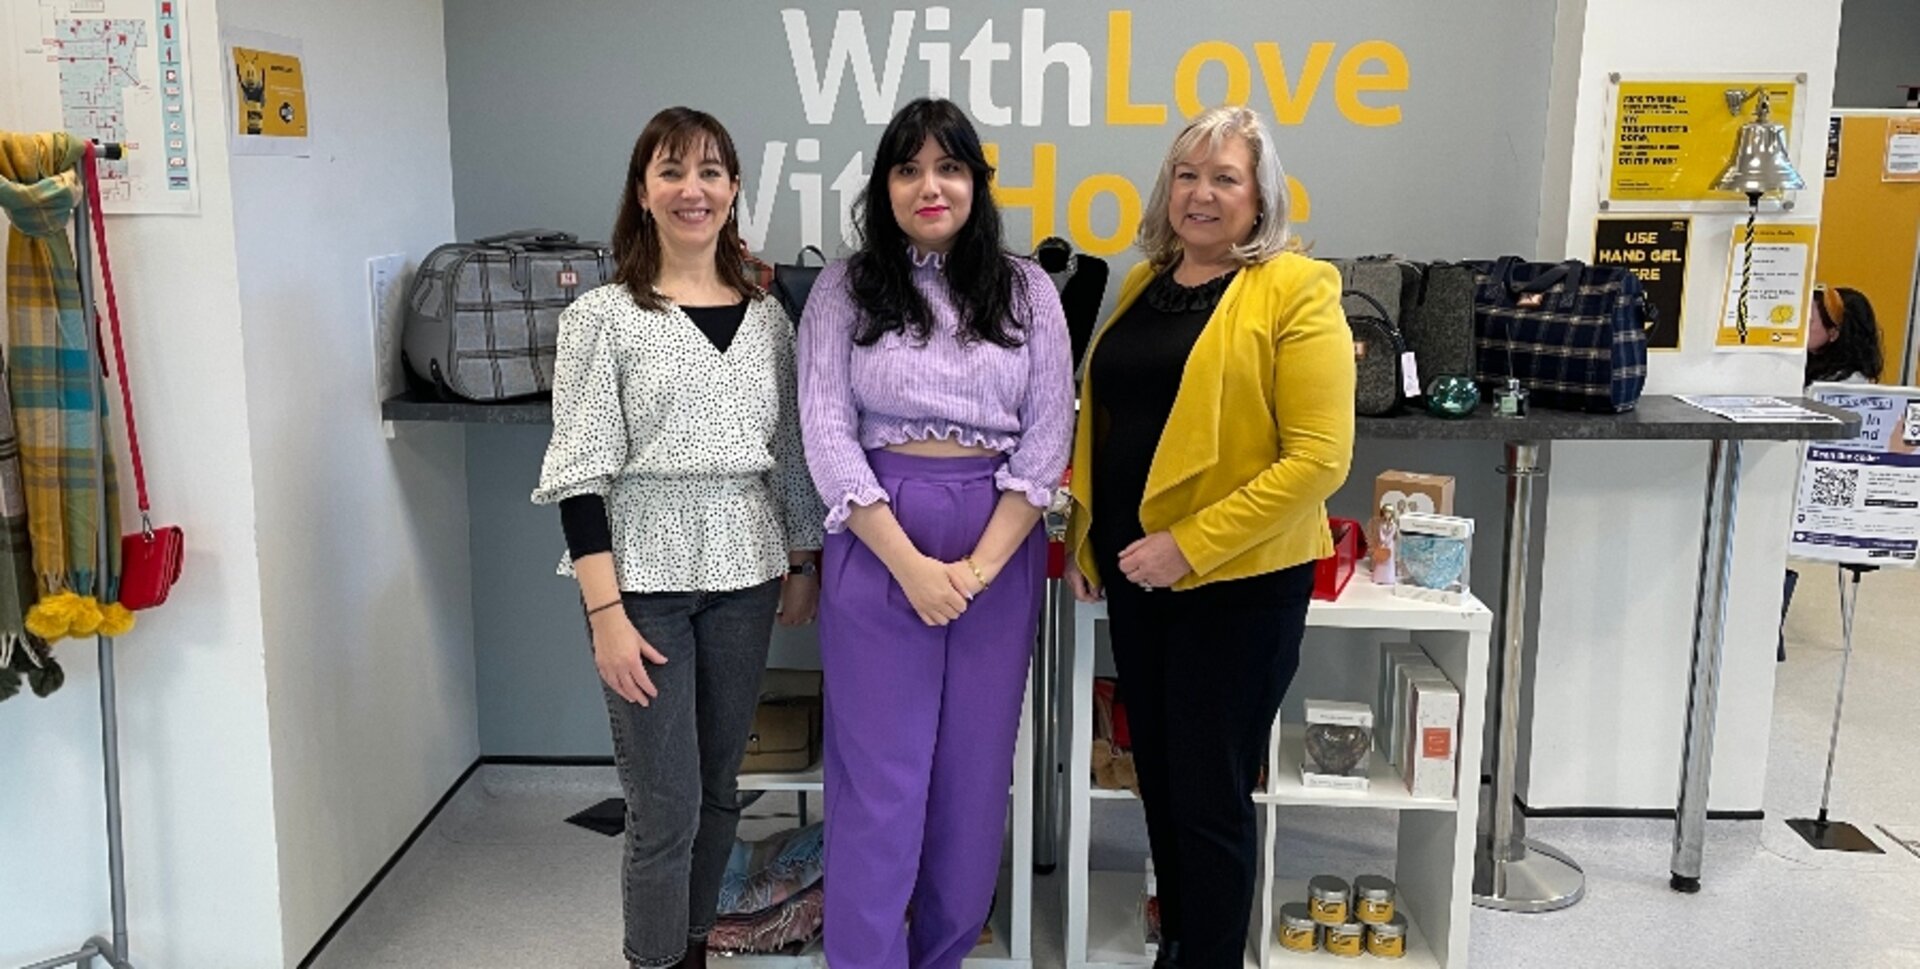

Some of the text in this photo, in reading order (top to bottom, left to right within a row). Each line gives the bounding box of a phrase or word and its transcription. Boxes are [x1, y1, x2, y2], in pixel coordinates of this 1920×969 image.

[1625, 232, 1658, 244] USE
[1599, 249, 1682, 263] HAND GEL
